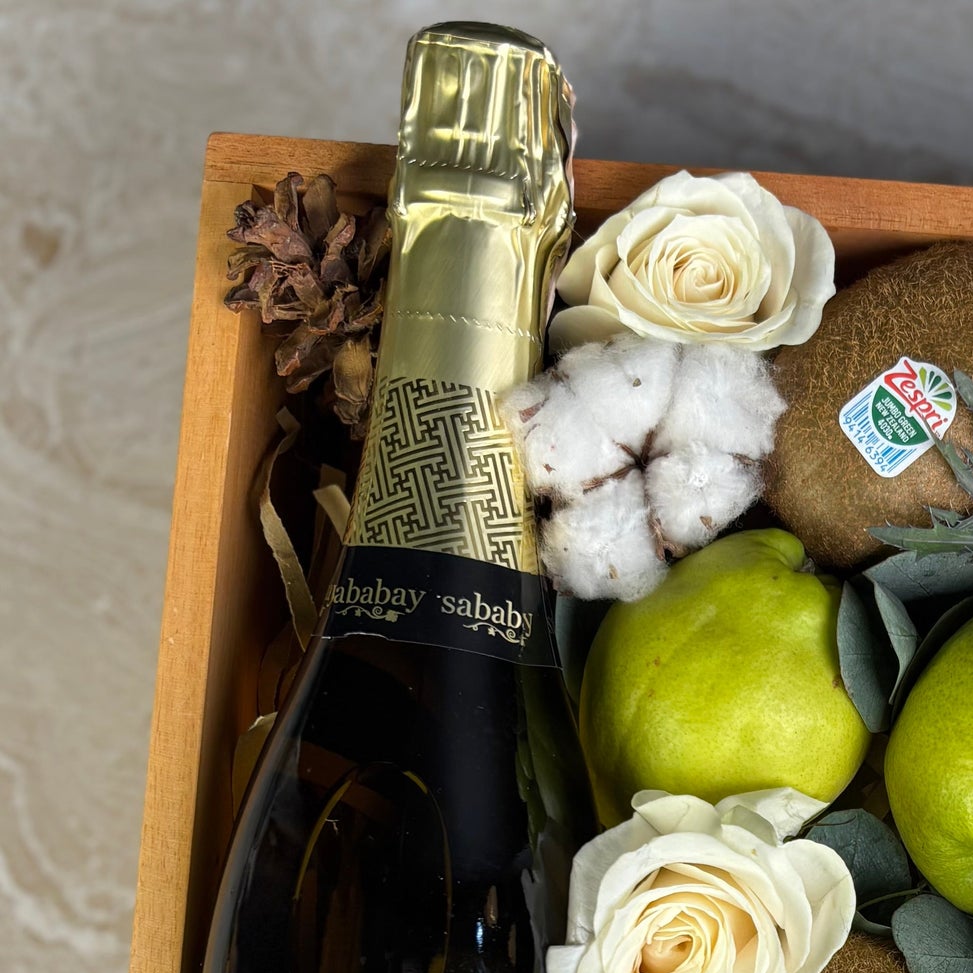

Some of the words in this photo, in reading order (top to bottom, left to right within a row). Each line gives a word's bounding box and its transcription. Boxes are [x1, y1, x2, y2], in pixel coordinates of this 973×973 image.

[881, 397, 902, 419] JUMBO
[897, 415, 917, 438] GREEN
[884, 359, 948, 431] Zespri
[843, 416, 866, 443] 9414
[865, 446, 888, 472] 6394
[875, 402, 890, 417] NEW
[886, 416, 909, 443] ZEALAND
